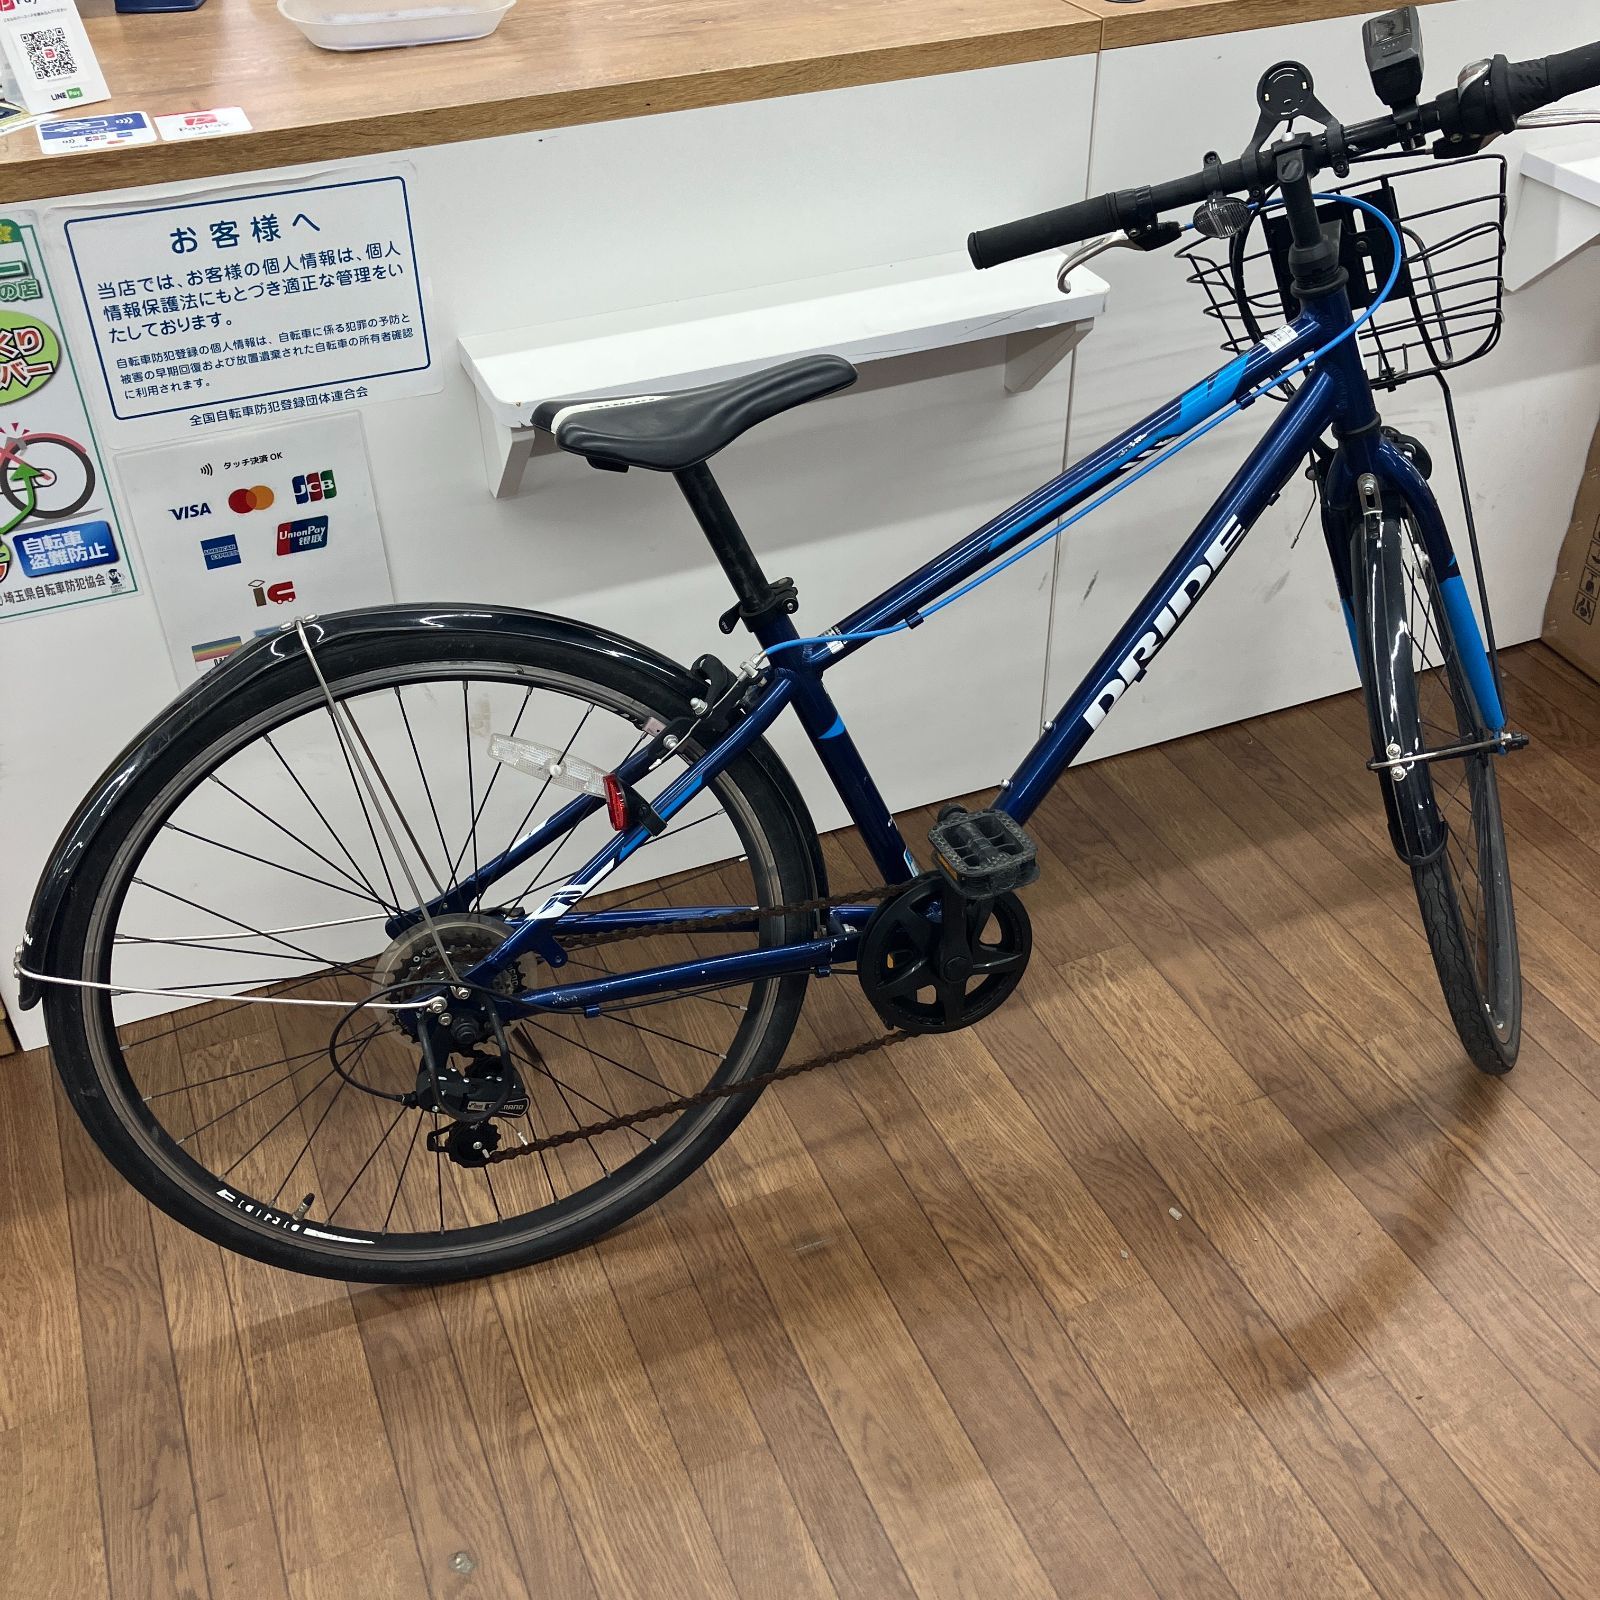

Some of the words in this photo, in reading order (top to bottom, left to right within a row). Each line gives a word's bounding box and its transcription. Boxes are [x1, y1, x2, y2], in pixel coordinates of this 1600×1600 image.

[51, 92, 67, 101] LINE
[68, 89, 82, 98] Pay
[170, 212, 320, 255] お客様へ
[97, 240, 401, 300] 当店では、お客様の個人情報は、個人
[0, 279, 41, 300] の店
[102, 264, 404, 322] 情報保護法にもとづき適正な管理をい
[108, 312, 234, 344] たしております。
[116, 312, 411, 370] 自転車防犯登録の個人情報は、自転車に係る犯罪の予防と
[119, 328, 415, 385] 被害の早期回復および放置遺棄された自転車の所有者確認
[124, 377, 211, 401] に利用されます。
[189, 386, 369, 427] 全国自転車防犯登録団体連合会
[223, 454, 268, 470] タッチ決済
[270, 452, 283, 461] OK
[294, 479, 334, 496] JCB
[168, 503, 212, 520] VISA
[22, 530, 84, 555] 自転車
[279, 525, 326, 541] UnionPay
[28, 542, 109, 570] 盗難防止
[0, 573, 106, 606] 埼玉県自転車防犯協会
[1083, 514, 1246, 731] DRIDE
